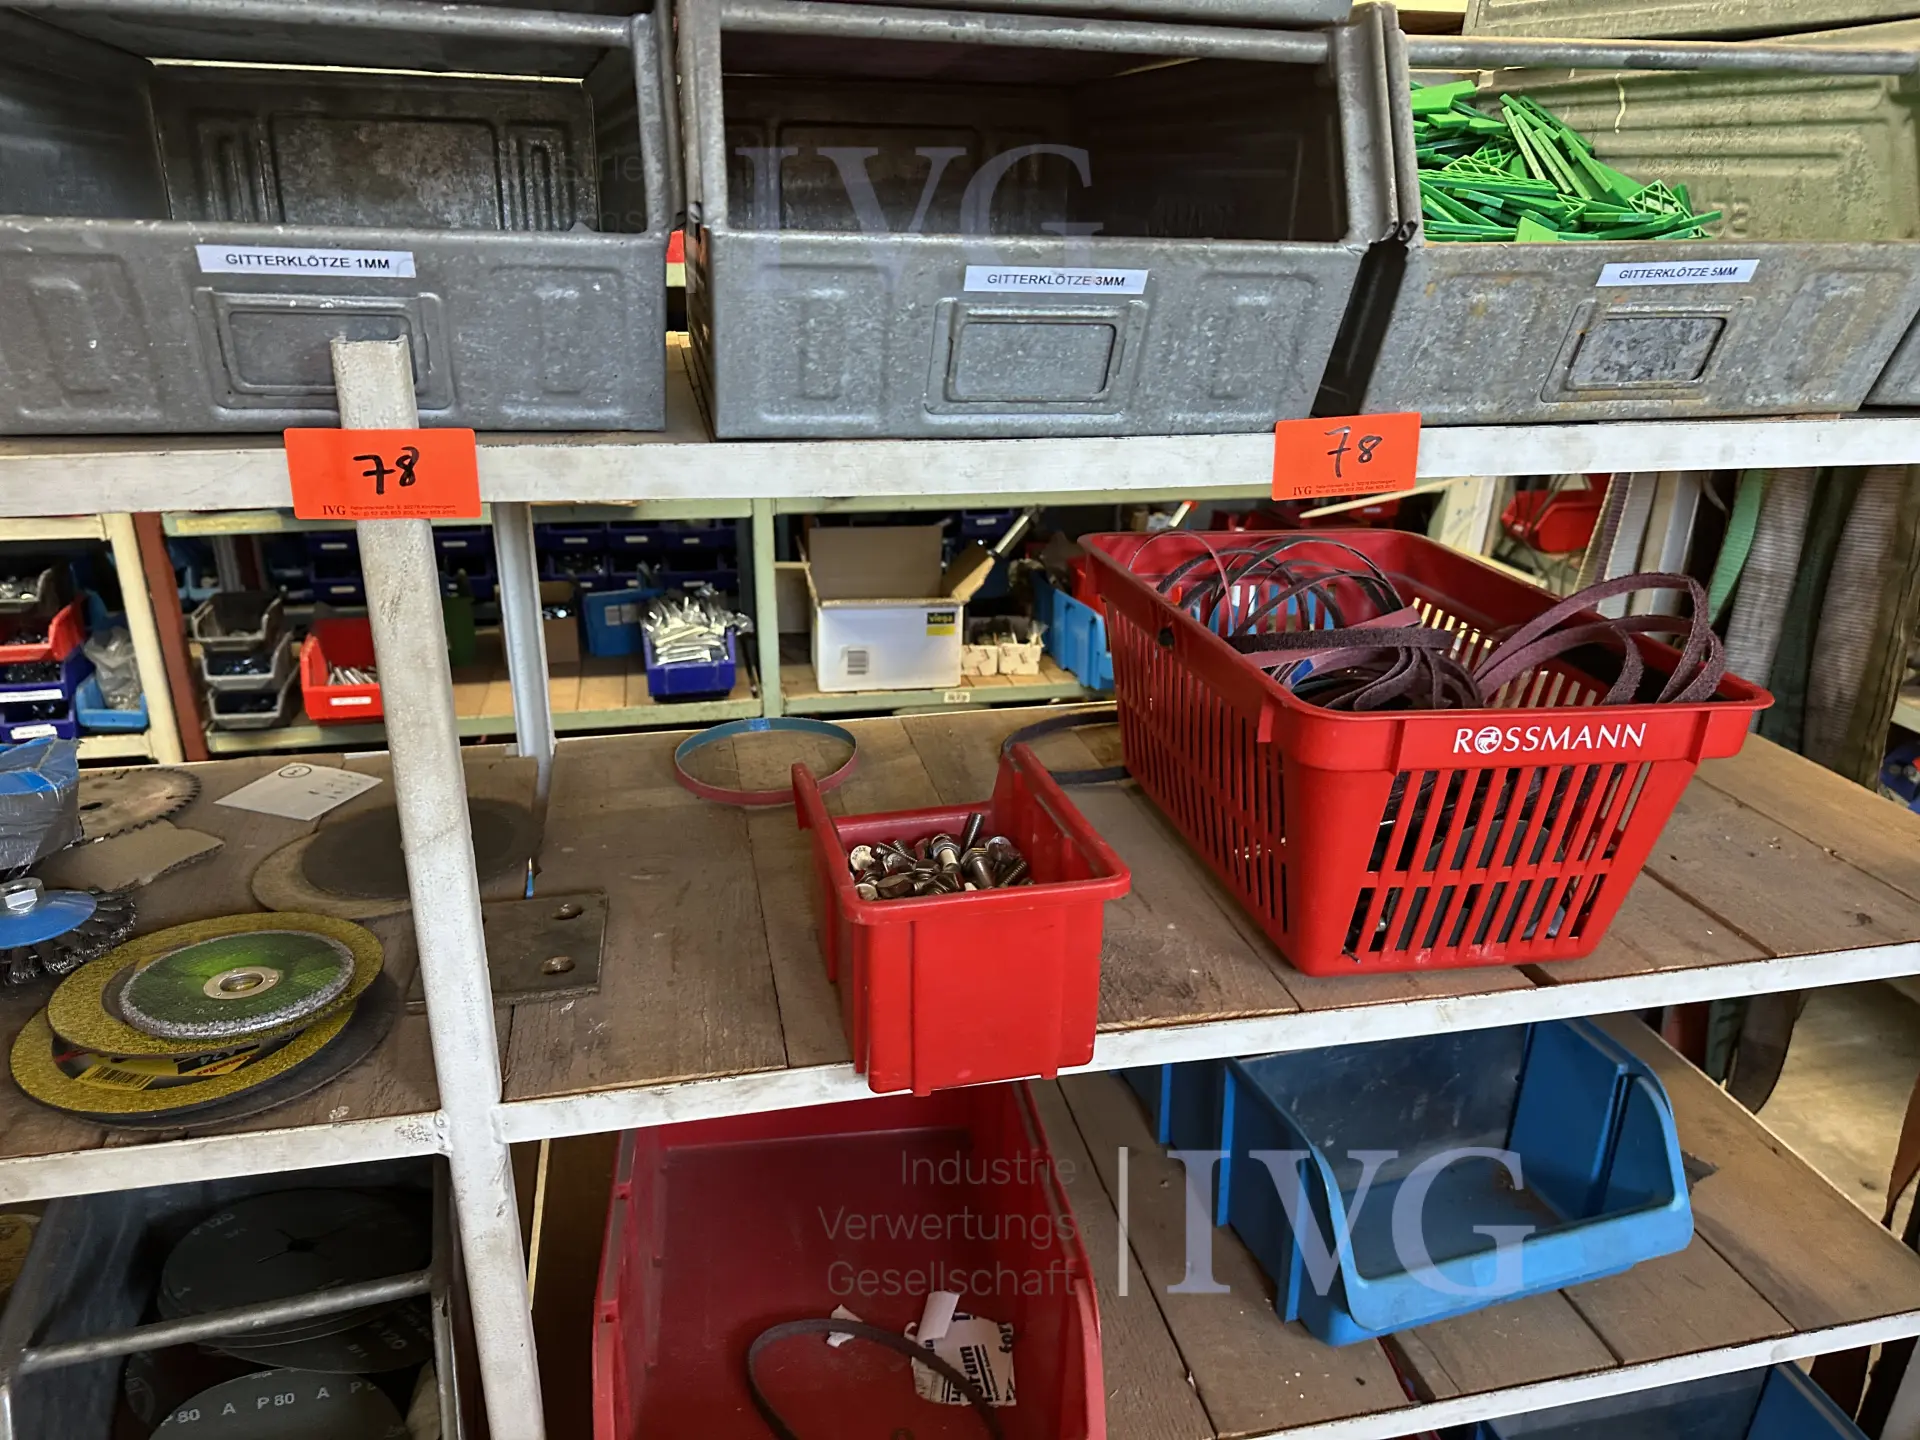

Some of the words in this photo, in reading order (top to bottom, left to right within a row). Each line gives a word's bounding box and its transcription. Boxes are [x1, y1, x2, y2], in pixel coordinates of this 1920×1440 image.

[225, 253, 351, 269] GITTERKLÖTZE
[356, 257, 390, 269] 1MM
[987, 273, 1092, 286] GITTERKLÖTZE
[1095, 275, 1126, 287] 3MM
[1618, 266, 1710, 280] GITTERKLÖTZE
[1710, 266, 1738, 278] 5MM
[1323, 425, 1383, 478] 78
[353, 446, 420, 495] 78
[1292, 485, 1312, 496] IVG
[322, 504, 346, 516] IVG
[1452, 722, 1647, 754] ROSSMANN
[221, 1402, 237, 1416] A
[316, 1386, 331, 1400] A
